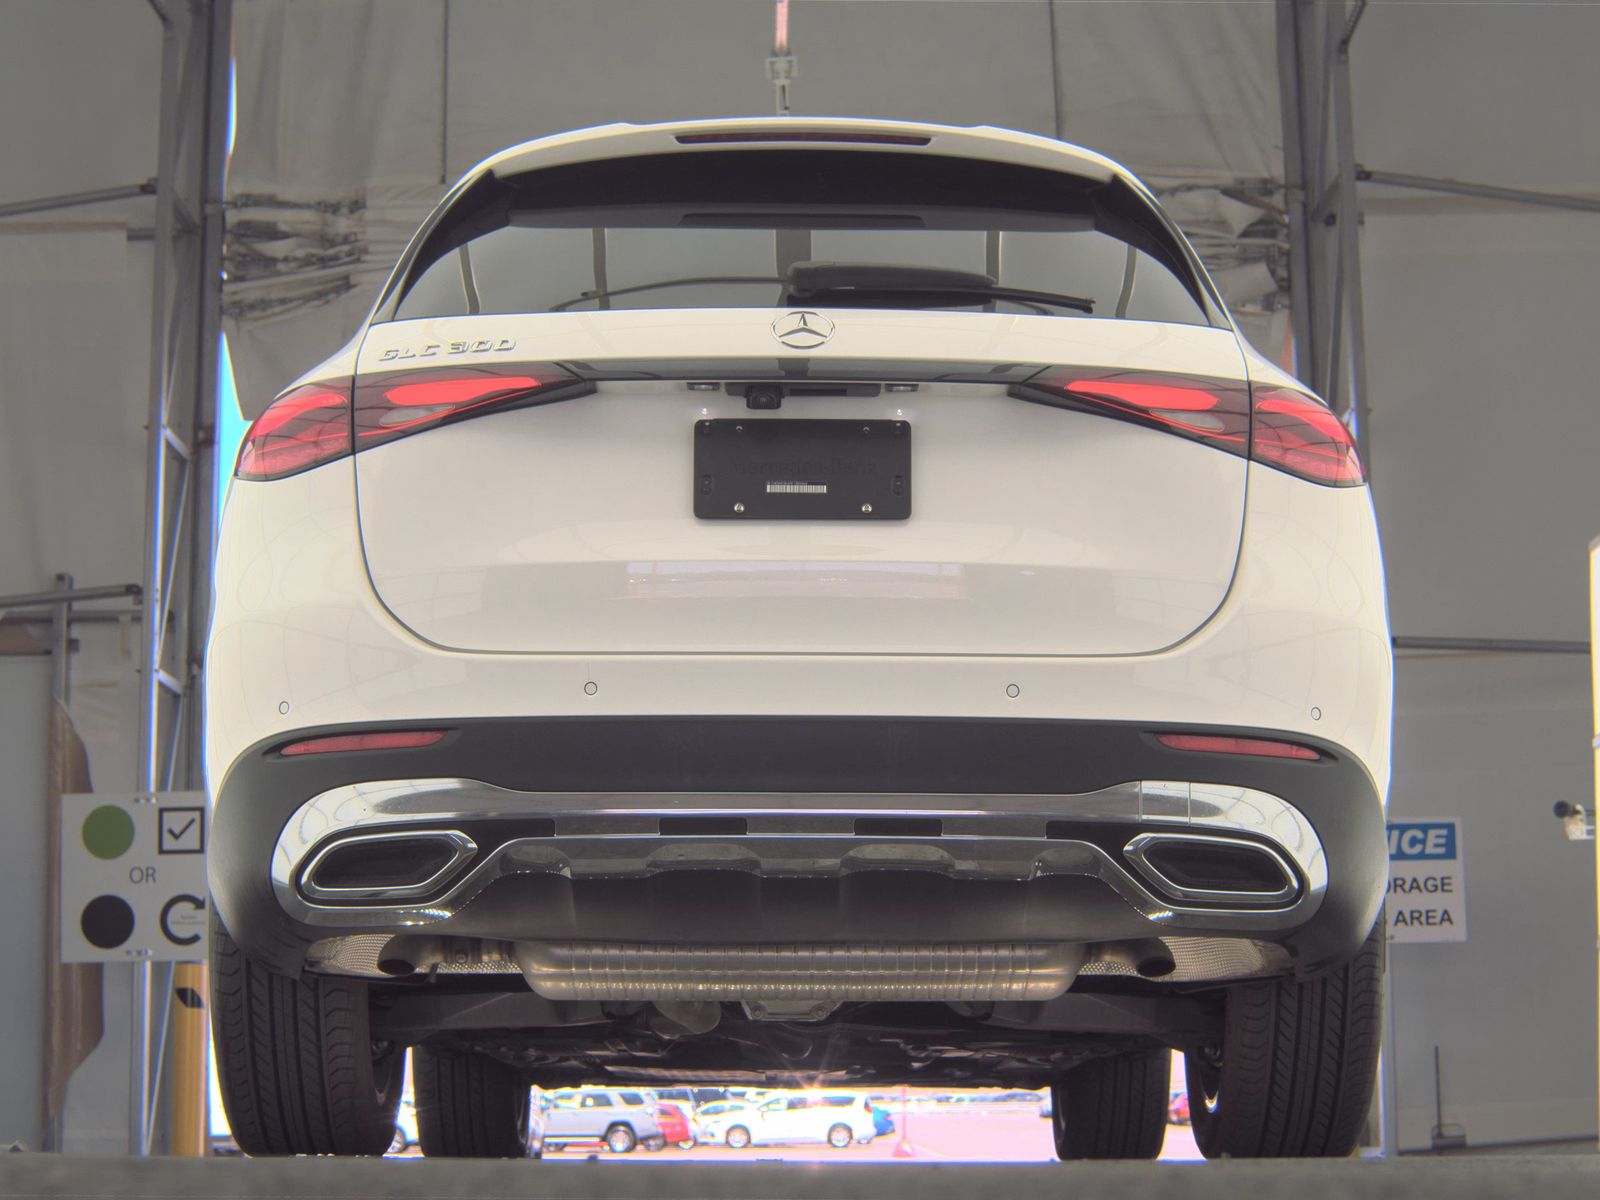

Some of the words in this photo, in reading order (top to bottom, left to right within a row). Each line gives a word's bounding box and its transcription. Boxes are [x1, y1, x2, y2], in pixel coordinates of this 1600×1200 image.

[379, 344, 440, 362] GLC
[447, 339, 517, 355] 300
[129, 866, 157, 884] OR
[1386, 876, 1453, 894] RAGE
[1393, 909, 1454, 926] AREA
